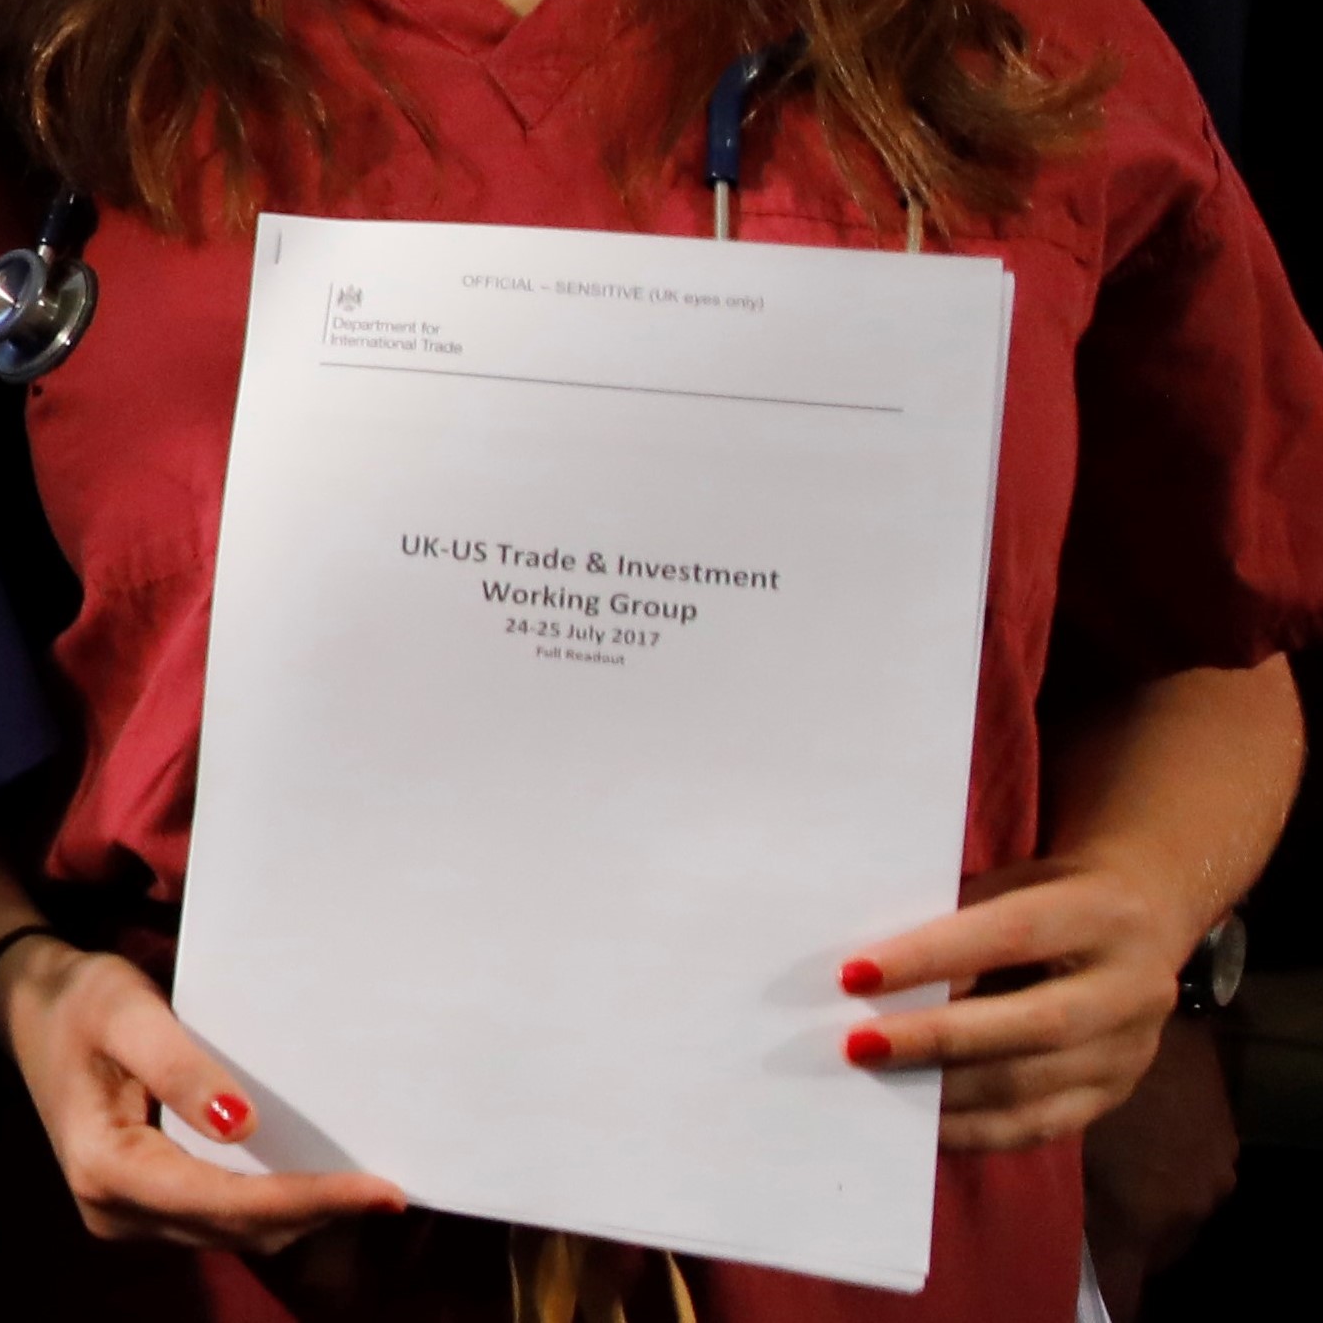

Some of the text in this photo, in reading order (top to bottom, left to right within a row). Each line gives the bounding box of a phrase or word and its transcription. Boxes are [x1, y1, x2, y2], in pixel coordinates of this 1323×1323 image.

[402, 534, 779, 590] UK-US Trade & Investment
[482, 580, 697, 625] Working Group
[506, 618, 660, 647] 24-25 July 2017
[536, 645, 625, 665] Full Readout
